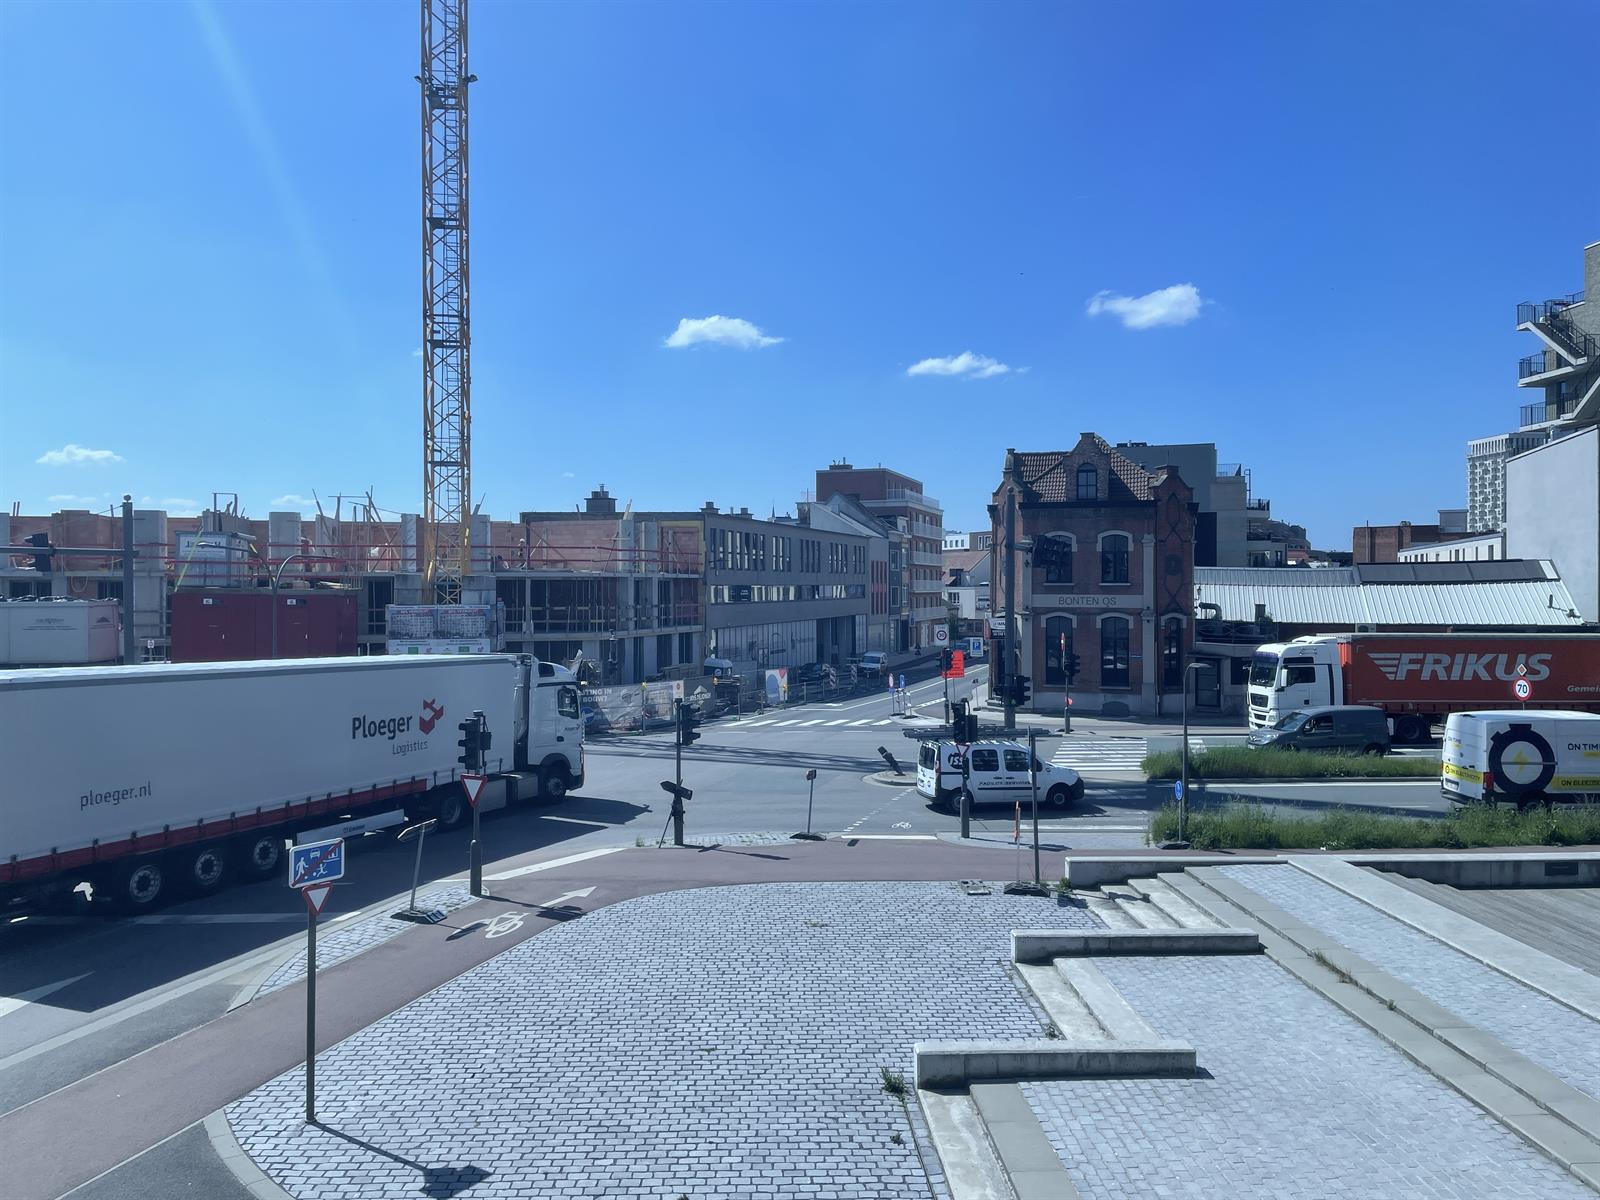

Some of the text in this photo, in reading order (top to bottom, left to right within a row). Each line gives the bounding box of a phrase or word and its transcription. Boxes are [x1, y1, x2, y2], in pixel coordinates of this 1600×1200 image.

[1058, 596, 1117, 607] BONTEN QS
[1394, 653, 1553, 681] FRIKUS
[1517, 683, 1528, 694] 70
[1568, 684, 1600, 692] Gemei
[352, 714, 413, 740] Ploeger
[392, 740, 428, 756] Logistics
[1567, 742, 1600, 751] ON TIM
[80, 780, 152, 811] ploeger.nl
